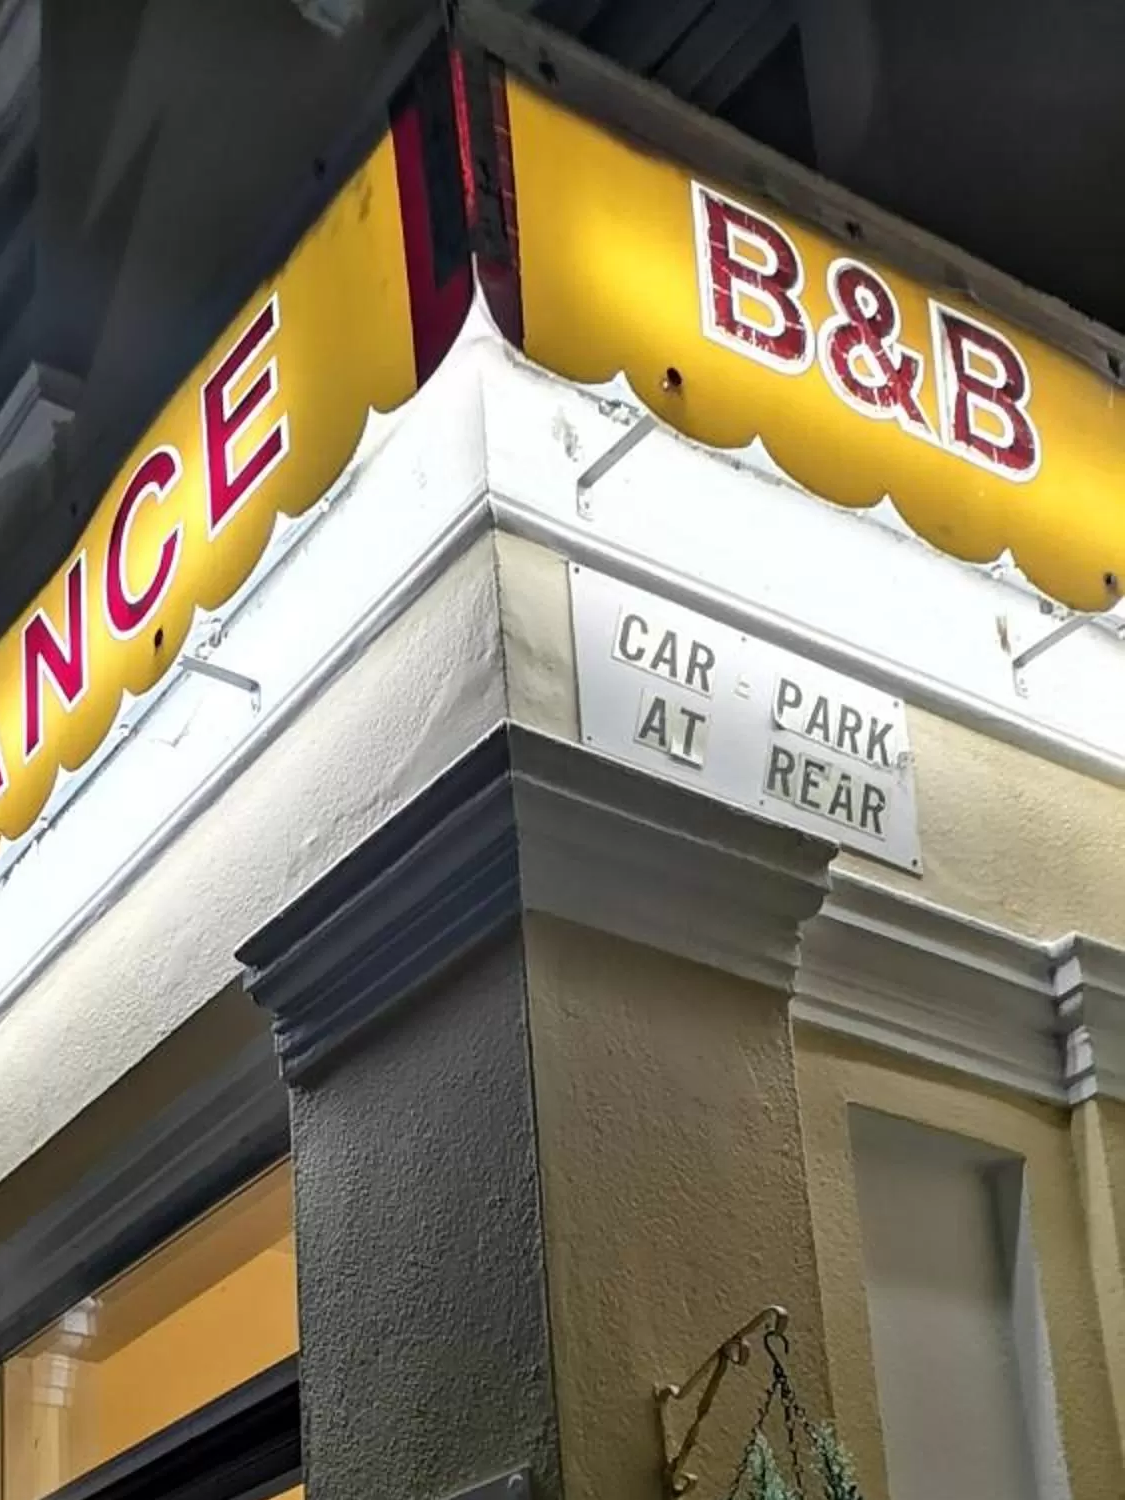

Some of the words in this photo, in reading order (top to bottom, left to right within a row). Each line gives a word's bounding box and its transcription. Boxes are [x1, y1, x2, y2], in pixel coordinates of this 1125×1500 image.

[691, 179, 1041, 483] B&B
[618, 613, 716, 692] CAR
[776, 677, 894, 768] PARK
[638, 695, 706, 756] AT
[766, 743, 887, 834] REAR
